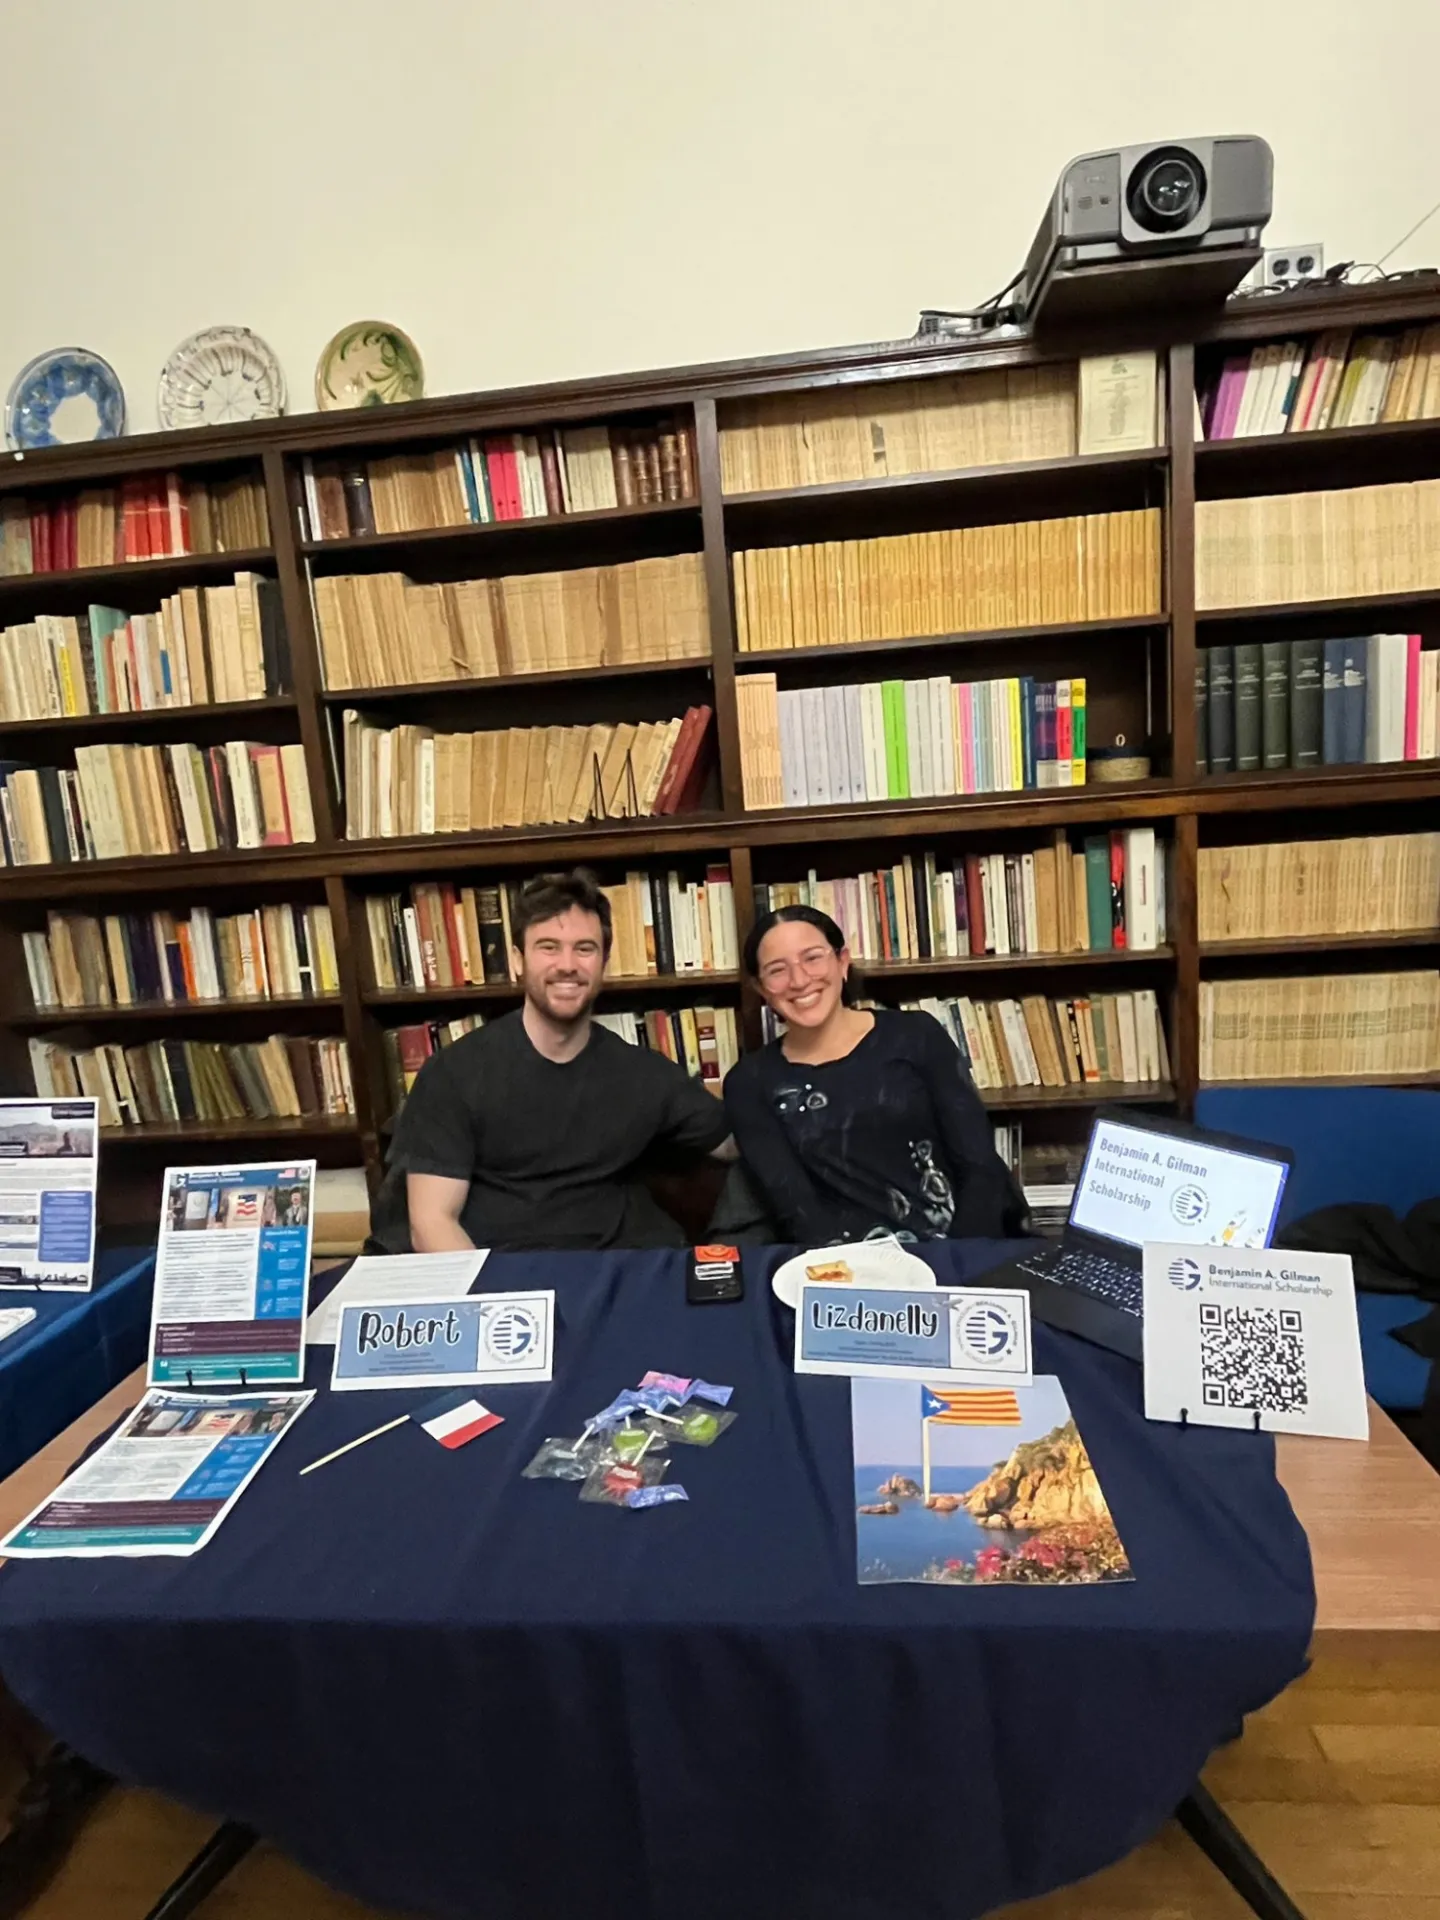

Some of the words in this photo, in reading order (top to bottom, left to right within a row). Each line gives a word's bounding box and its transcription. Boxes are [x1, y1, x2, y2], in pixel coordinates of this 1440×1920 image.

[1094, 1157, 1165, 1188] International
[1099, 1137, 1150, 1163] Benjamin
[1151, 1151, 1163, 1167] A.
[1166, 1155, 1208, 1179] Gilman
[1089, 1179, 1152, 1211] Scholarship
[1208, 1264, 1263, 1279] Benjamin
[1265, 1269, 1277, 1280] A.
[1280, 1269, 1321, 1282] Gilman
[1209, 1277, 1272, 1291] International
[1275, 1280, 1334, 1298] Scholarship
[358, 1309, 461, 1355] Robert
[812, 1300, 938, 1338] Lizdanelly
